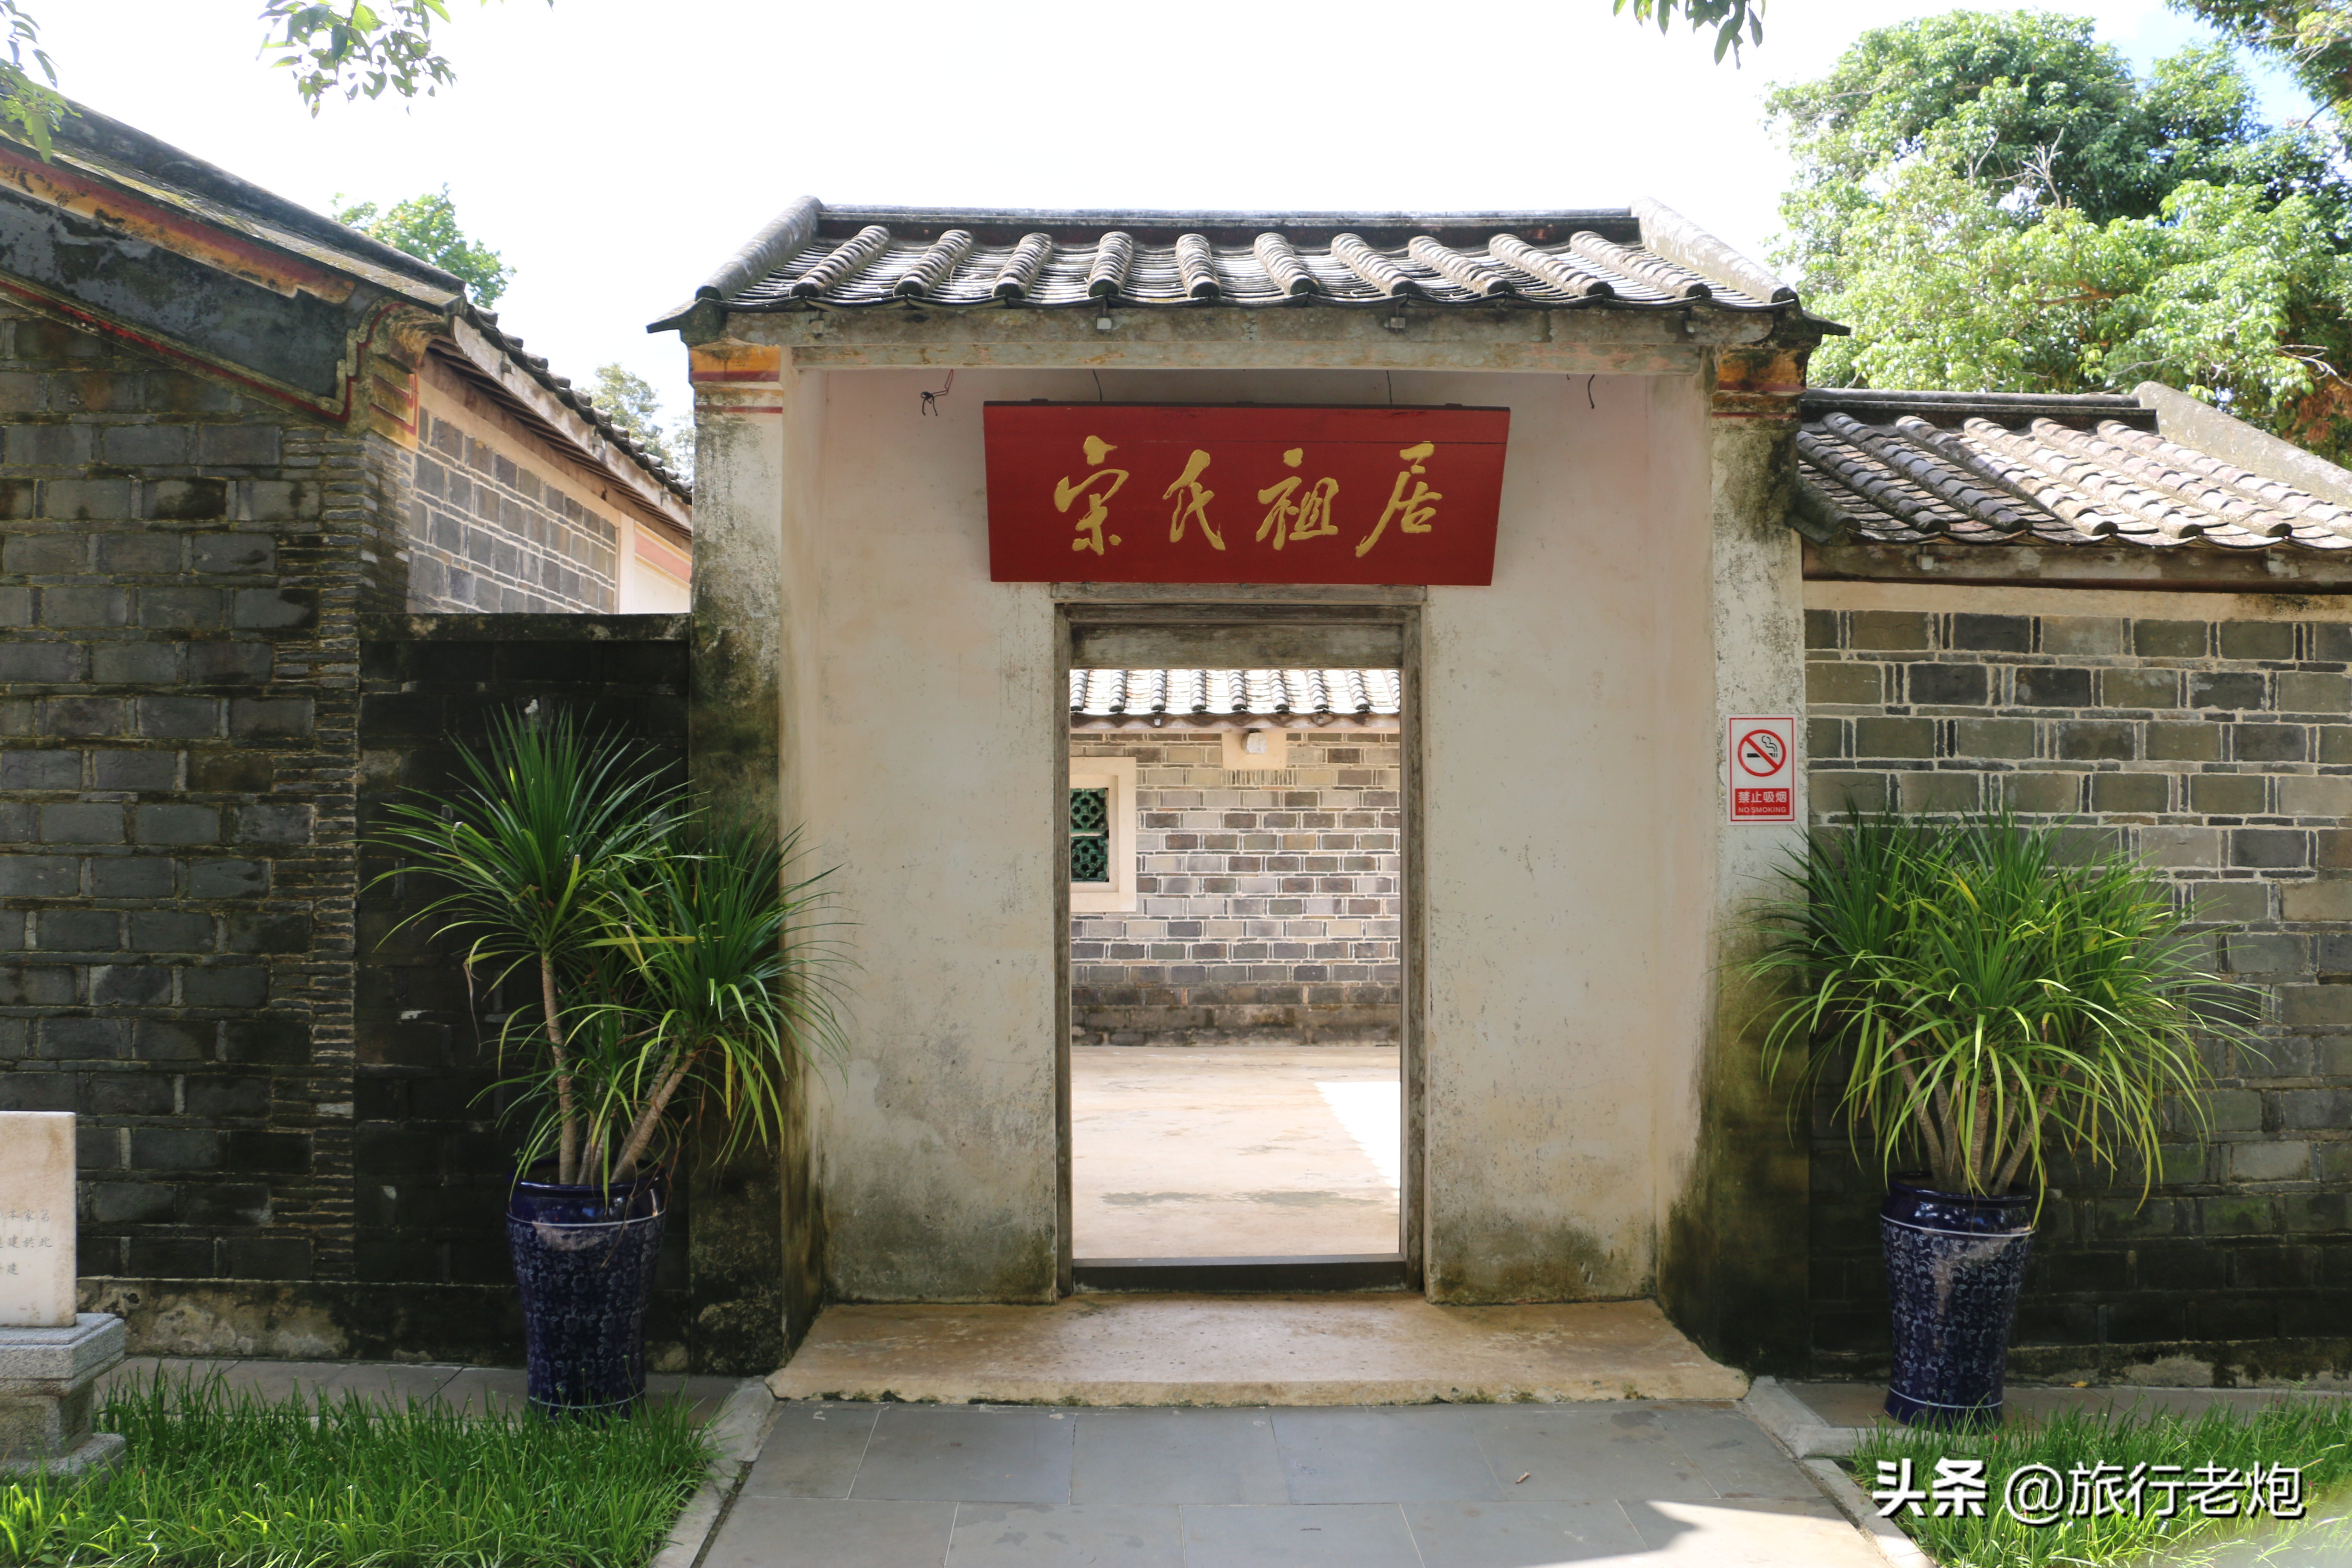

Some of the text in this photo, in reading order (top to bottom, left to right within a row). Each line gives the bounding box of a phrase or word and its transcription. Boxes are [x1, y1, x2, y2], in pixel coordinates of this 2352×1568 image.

[1053, 435, 1443, 558] 宋氏祖居
[1738, 791, 1787, 803] 禁止吸烟
[0, 1262, 19, 1275] 建
